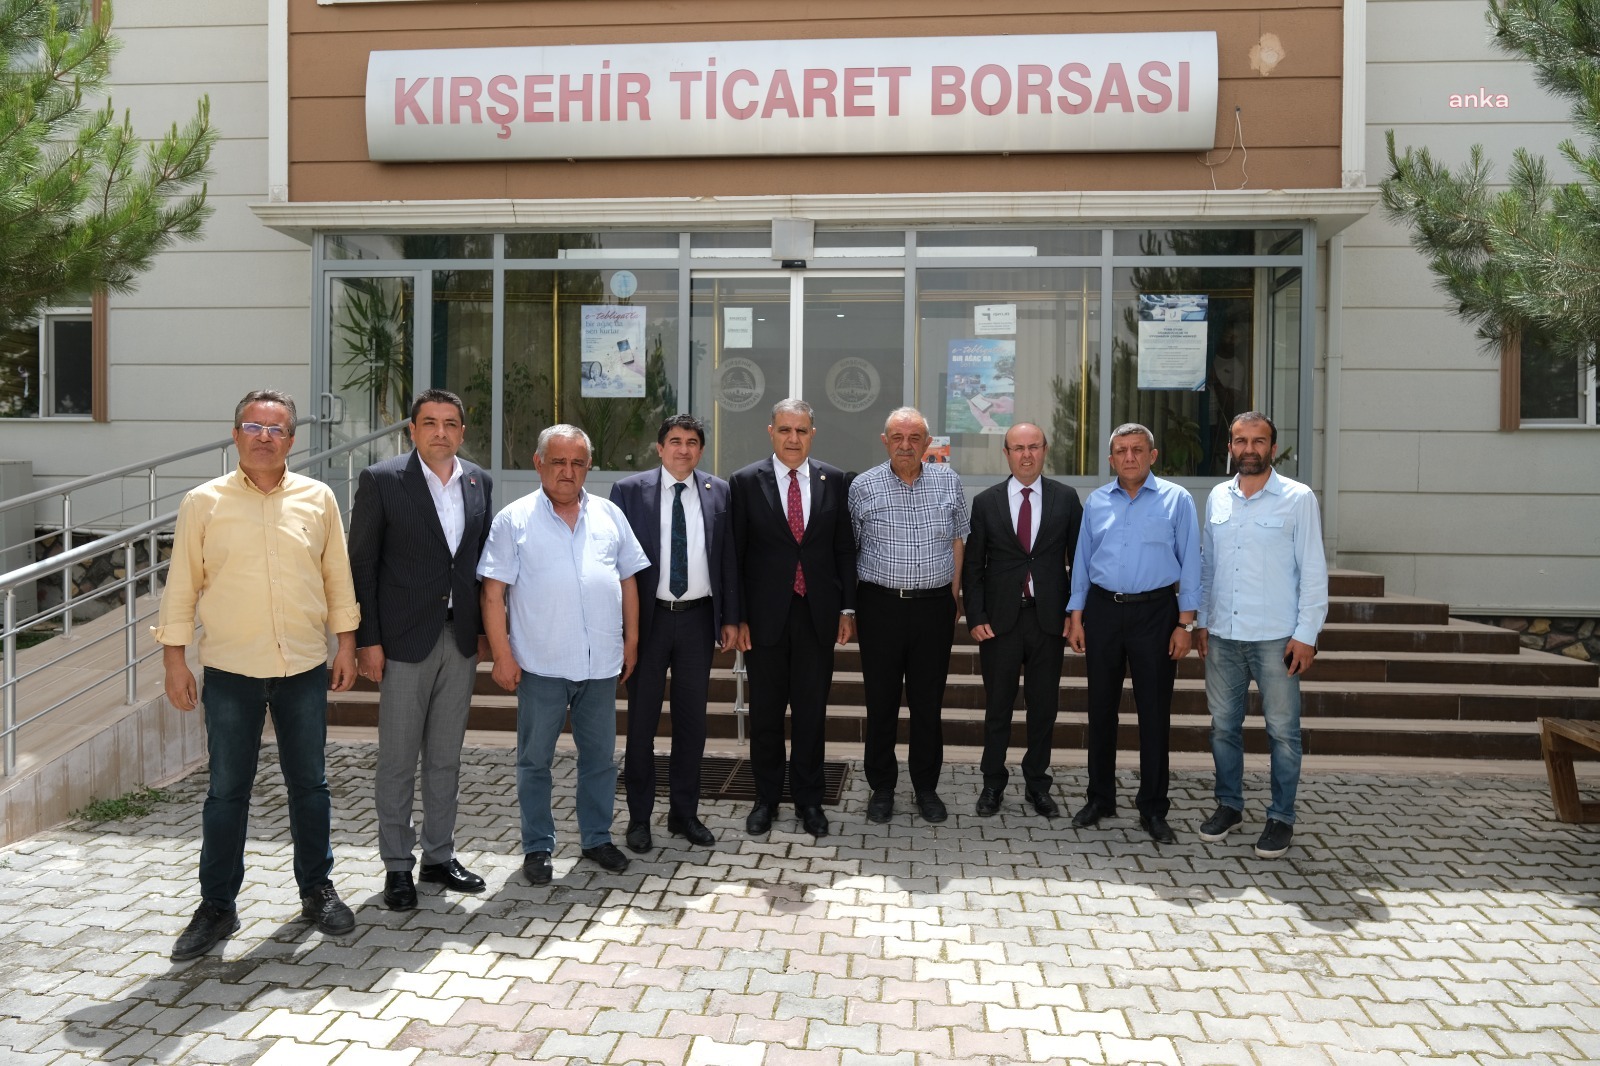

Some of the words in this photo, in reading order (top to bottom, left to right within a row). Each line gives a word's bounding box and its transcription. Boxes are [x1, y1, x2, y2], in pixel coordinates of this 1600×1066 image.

[394, 60, 652, 140] KIRŞEHİR
[669, 57, 912, 120] TİCARET
[931, 61, 1191, 116] BORSASI
